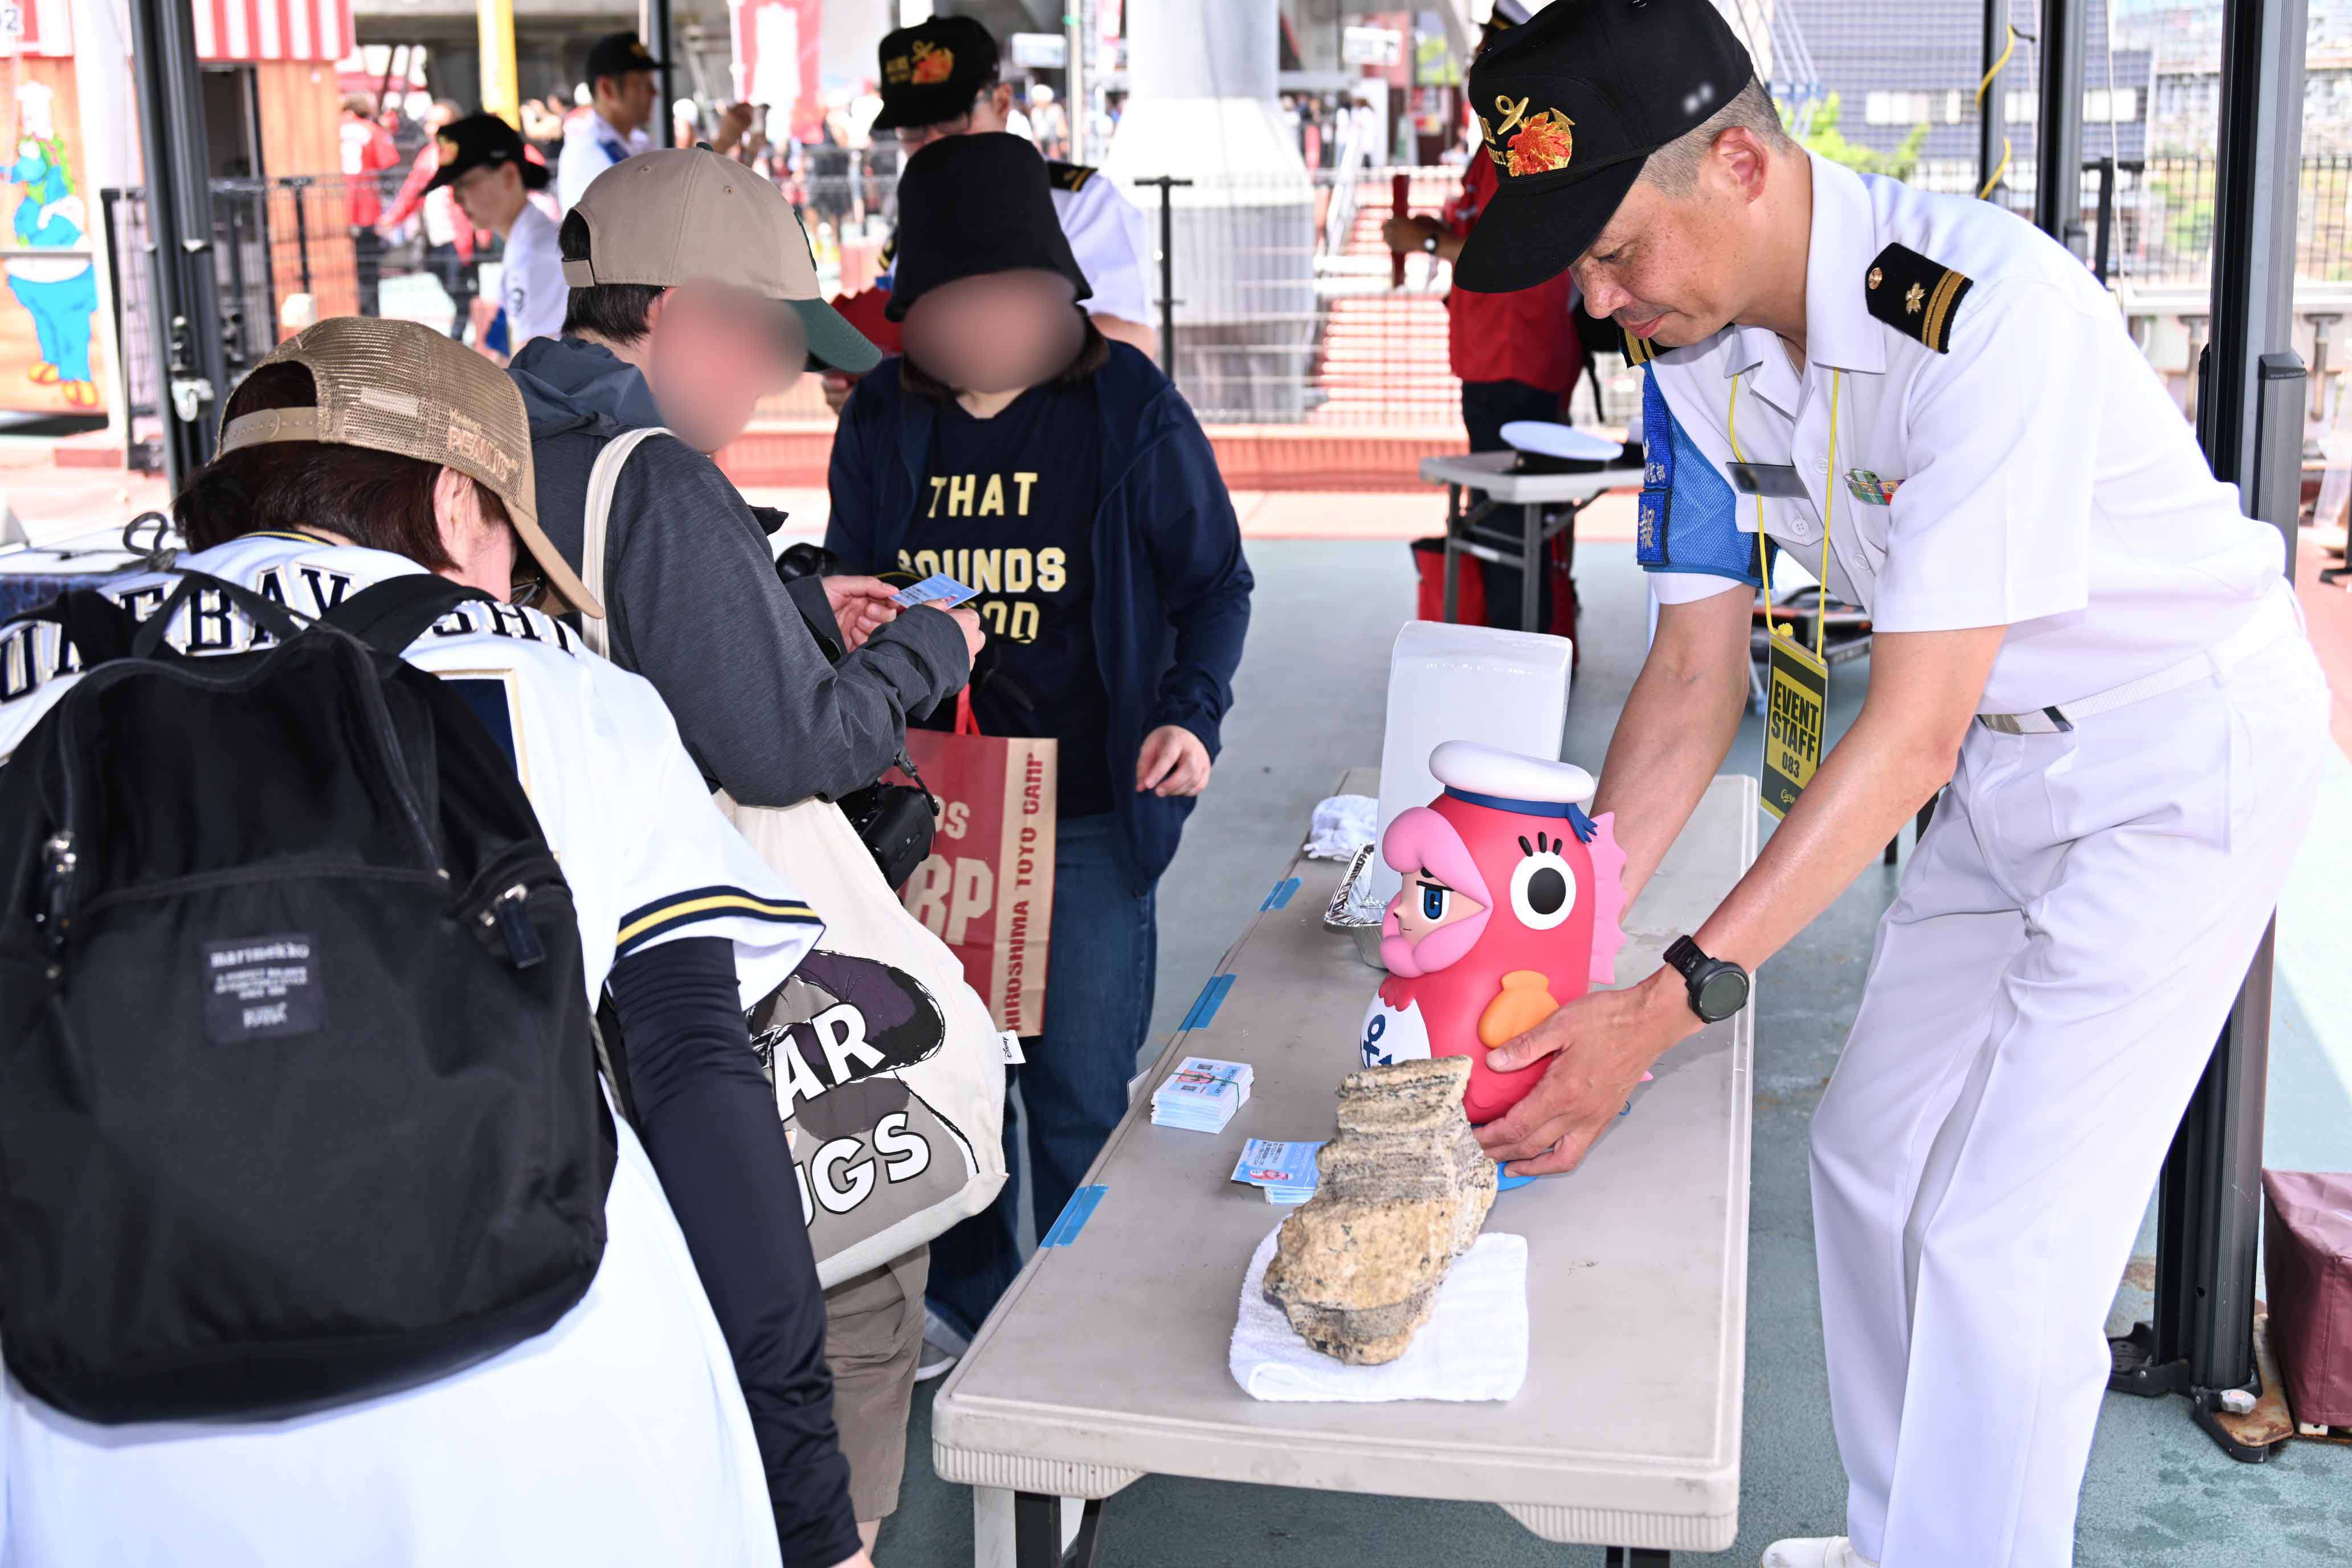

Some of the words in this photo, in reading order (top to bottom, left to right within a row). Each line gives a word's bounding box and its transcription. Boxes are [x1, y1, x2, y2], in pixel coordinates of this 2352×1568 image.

[928, 472, 1038, 518] THAT
[1773, 679, 1819, 735] EVENT
[1771, 710, 1816, 762] STAFF
[1023, 752, 1044, 815] CARP
[1782, 752, 1800, 779] 083
[1781, 789, 1796, 804] Carp
[1015, 828, 1037, 888] TOYO
[896, 854, 994, 946] RP
[210, 941, 310, 968] marimekko
[1006, 900, 1029, 1031] HIROSHIMA
